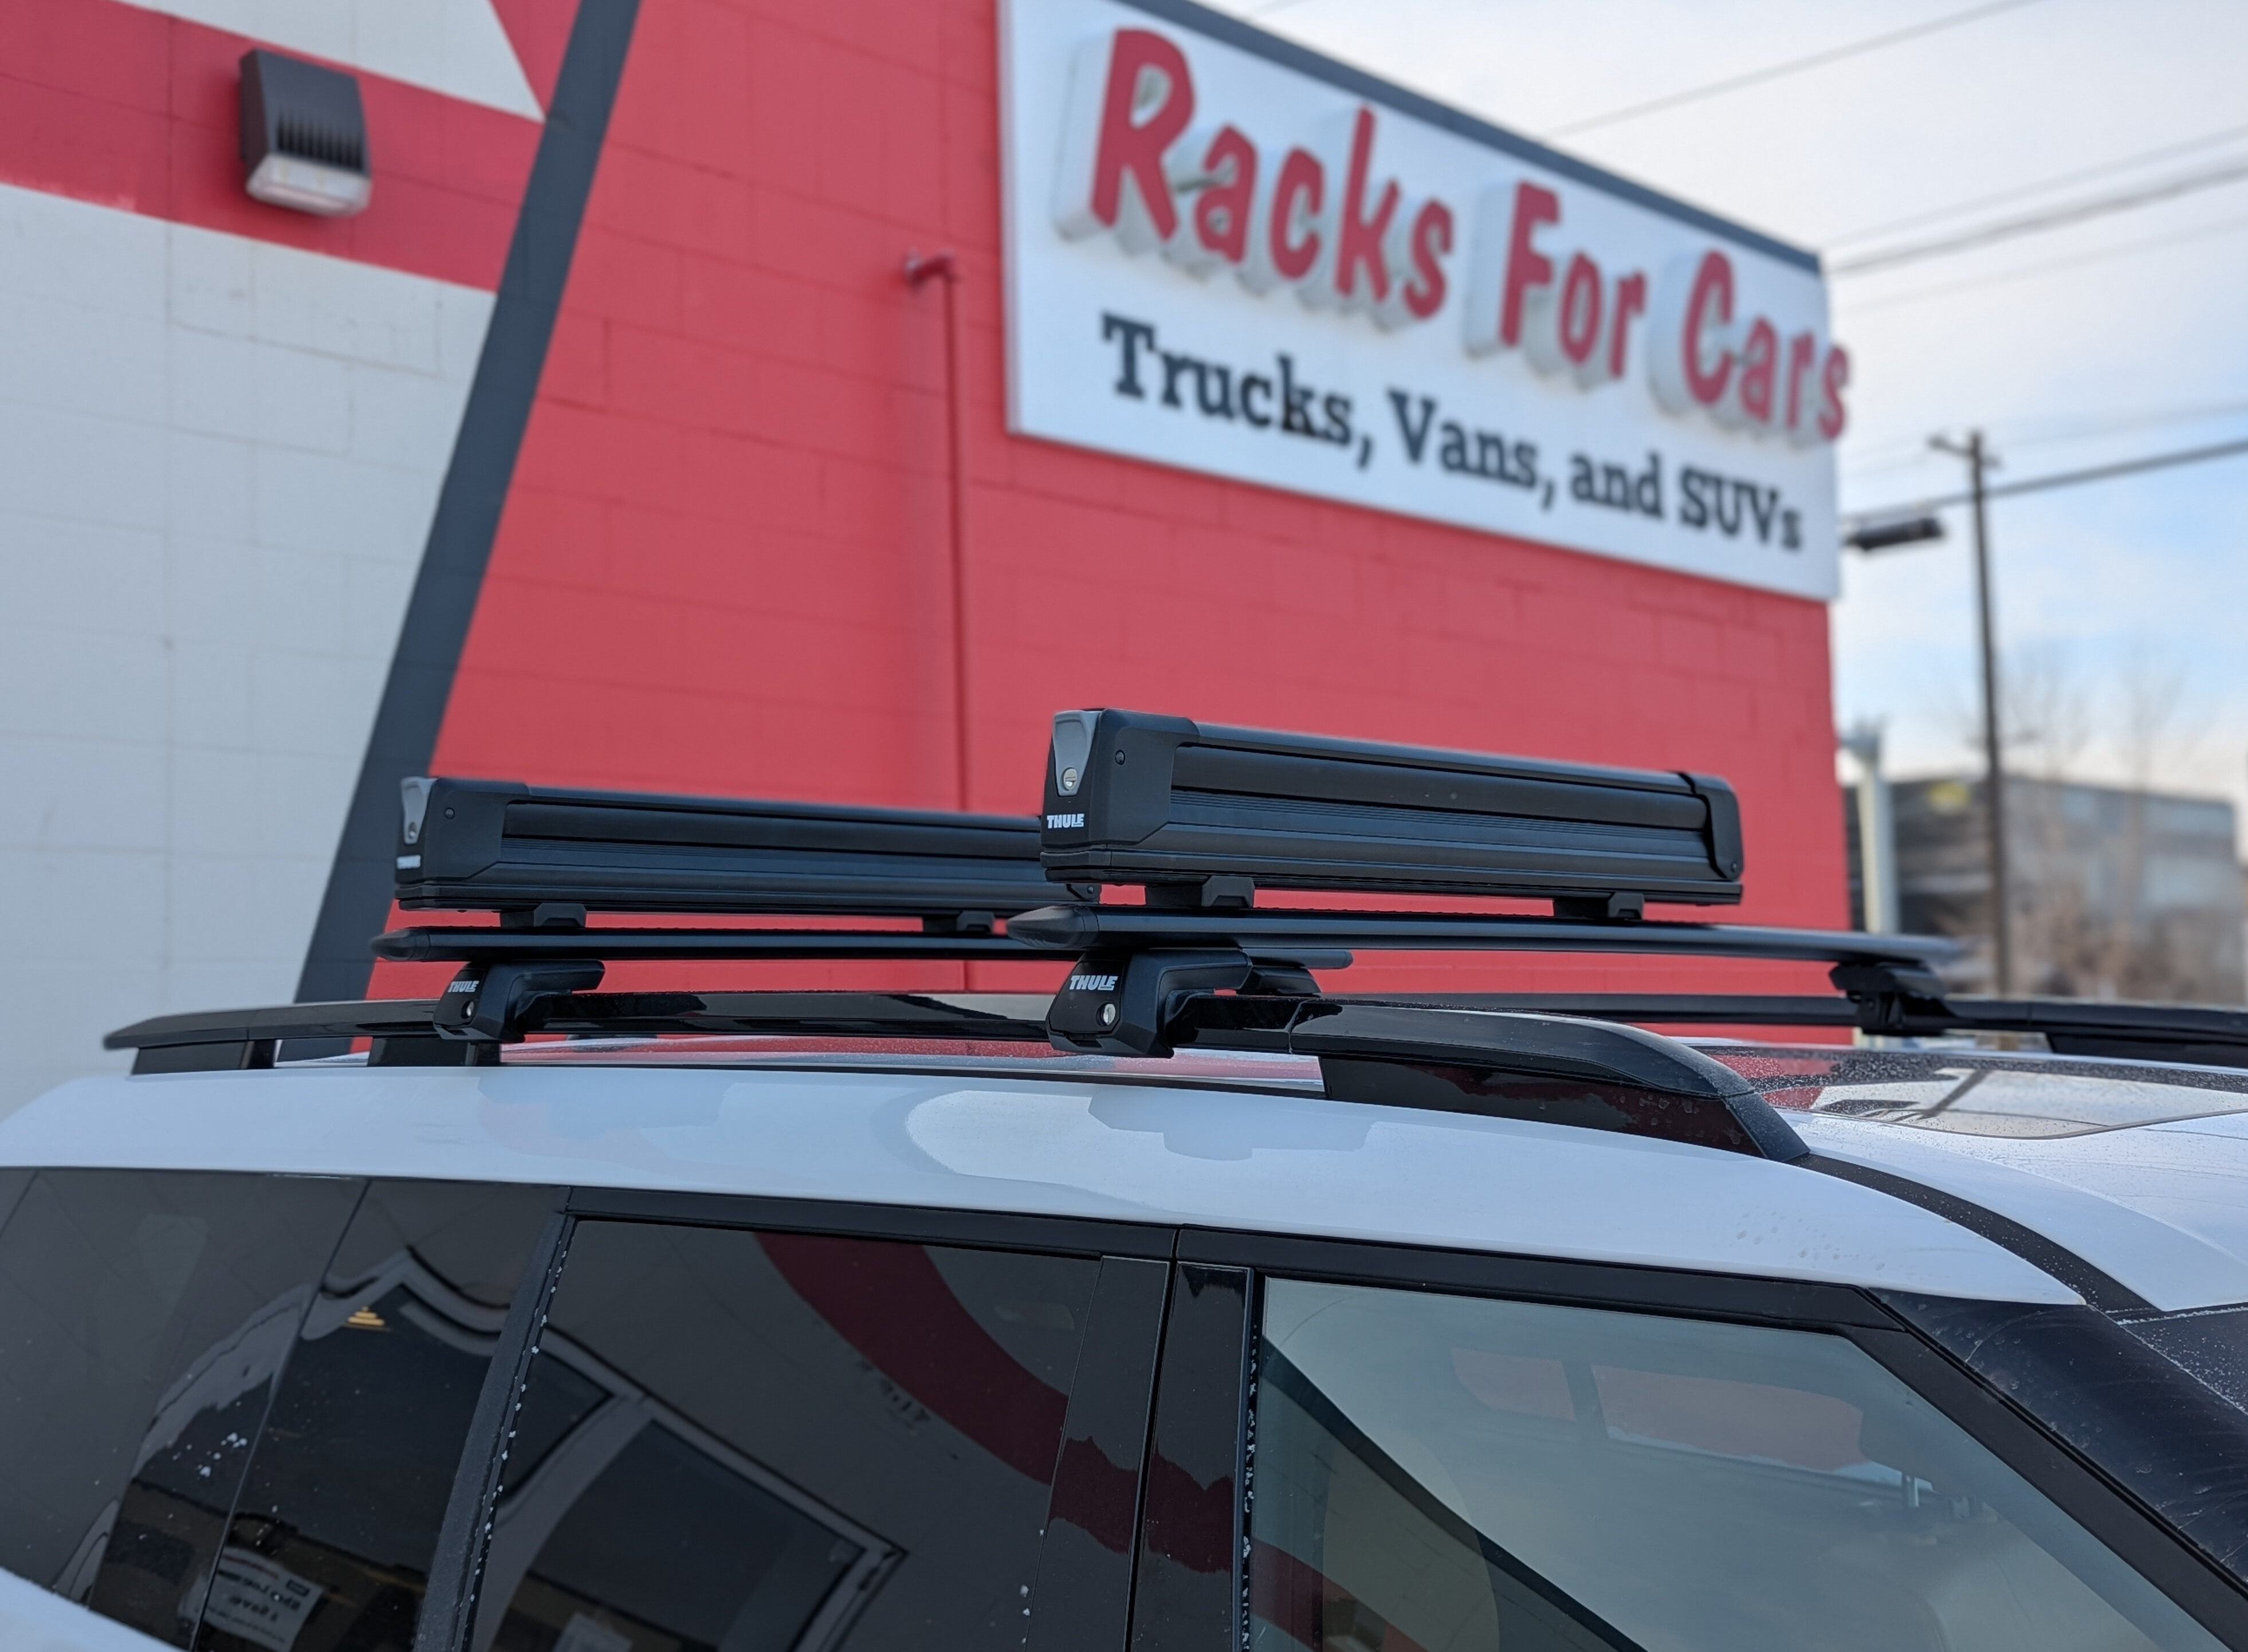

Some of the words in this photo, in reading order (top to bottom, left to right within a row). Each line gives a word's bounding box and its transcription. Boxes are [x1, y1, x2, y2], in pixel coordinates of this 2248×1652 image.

[1091, 27, 1453, 321] Racks
[1500, 180, 1646, 380] For
[1683, 249, 1851, 439] Cars
[1102, 313, 1374, 469] Trucks,
[1388, 389, 1555, 512] Vans,
[1571, 453, 1664, 520] and
[1680, 467, 1802, 551] SUVs
[1047, 813, 1084, 829] THULE
[448, 980, 480, 992] THULE
[1069, 975, 1118, 990] THULE
